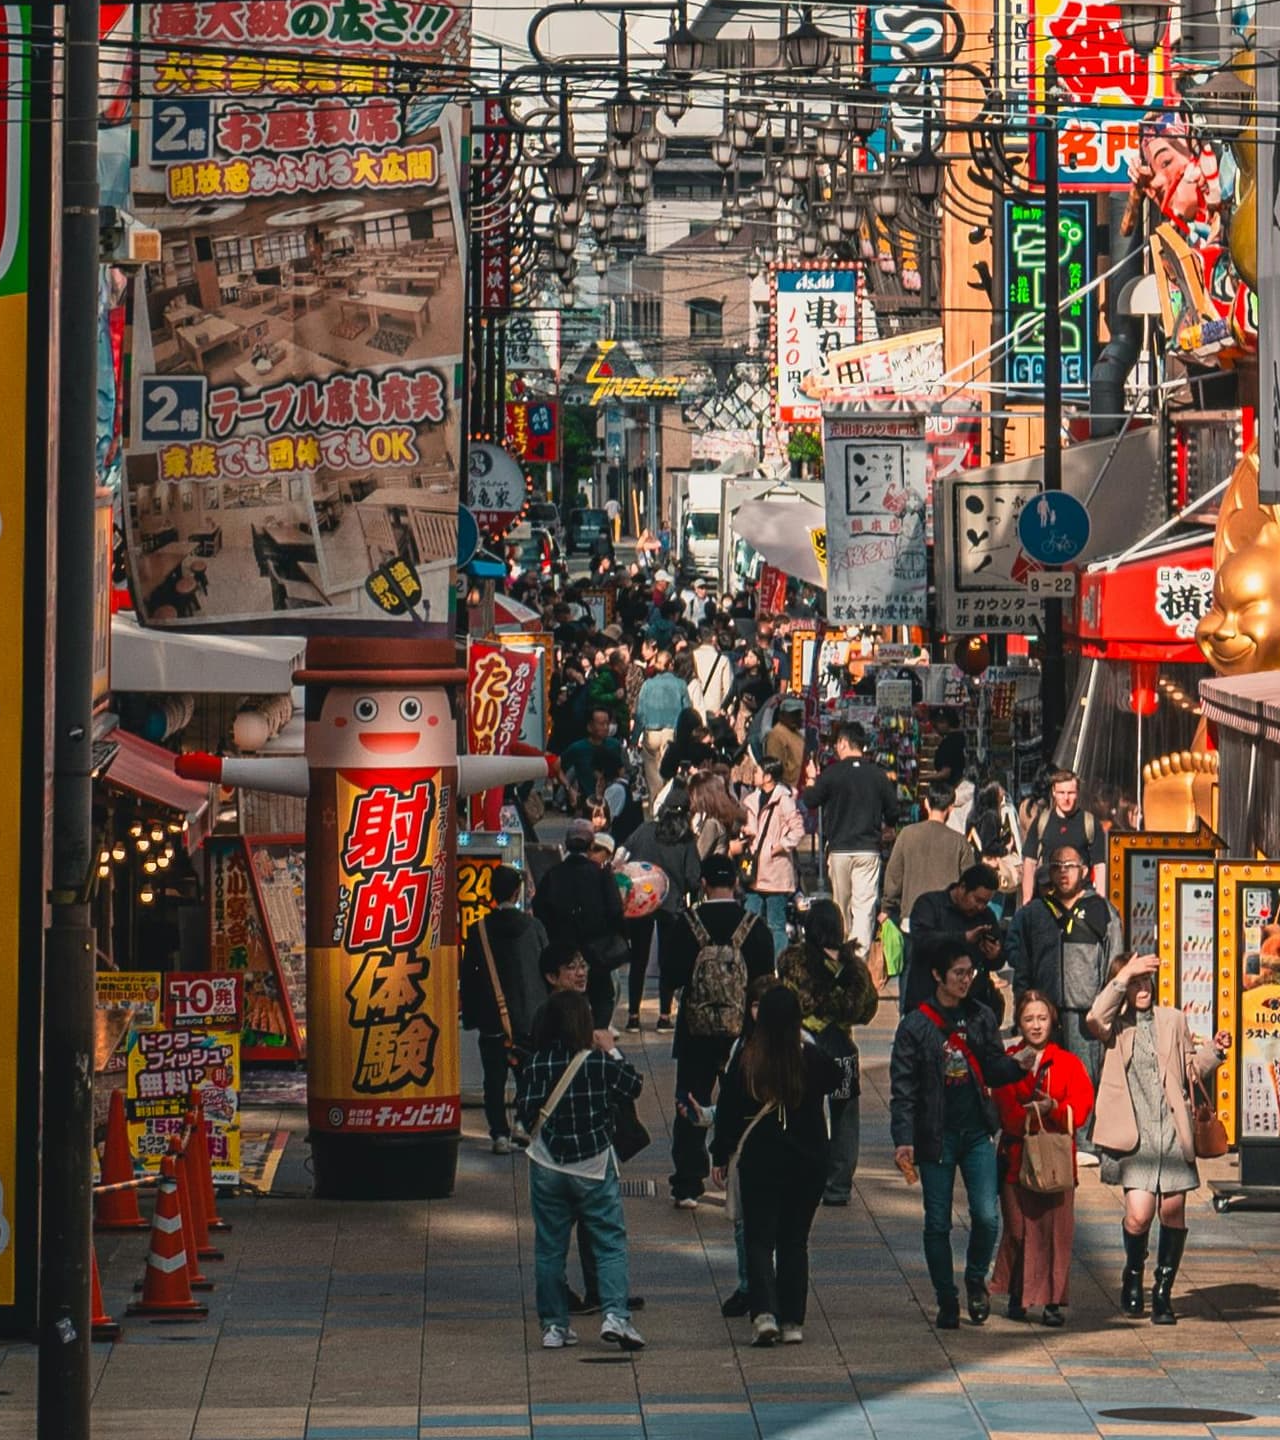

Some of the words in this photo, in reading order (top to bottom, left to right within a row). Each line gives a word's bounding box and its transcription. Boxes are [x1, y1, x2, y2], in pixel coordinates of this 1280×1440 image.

[155, 106, 206, 153] 2階
[221, 98, 401, 152] お座敷席
[795, 273, 835, 291] Asahi
[1012, 354, 1082, 385] GAE
[145, 385, 200, 433] 2階
[210, 374, 442, 431] テーブル席も充実
[344, 783, 434, 1086] 射的体験
[375, 1103, 456, 1127] チャンピオン
